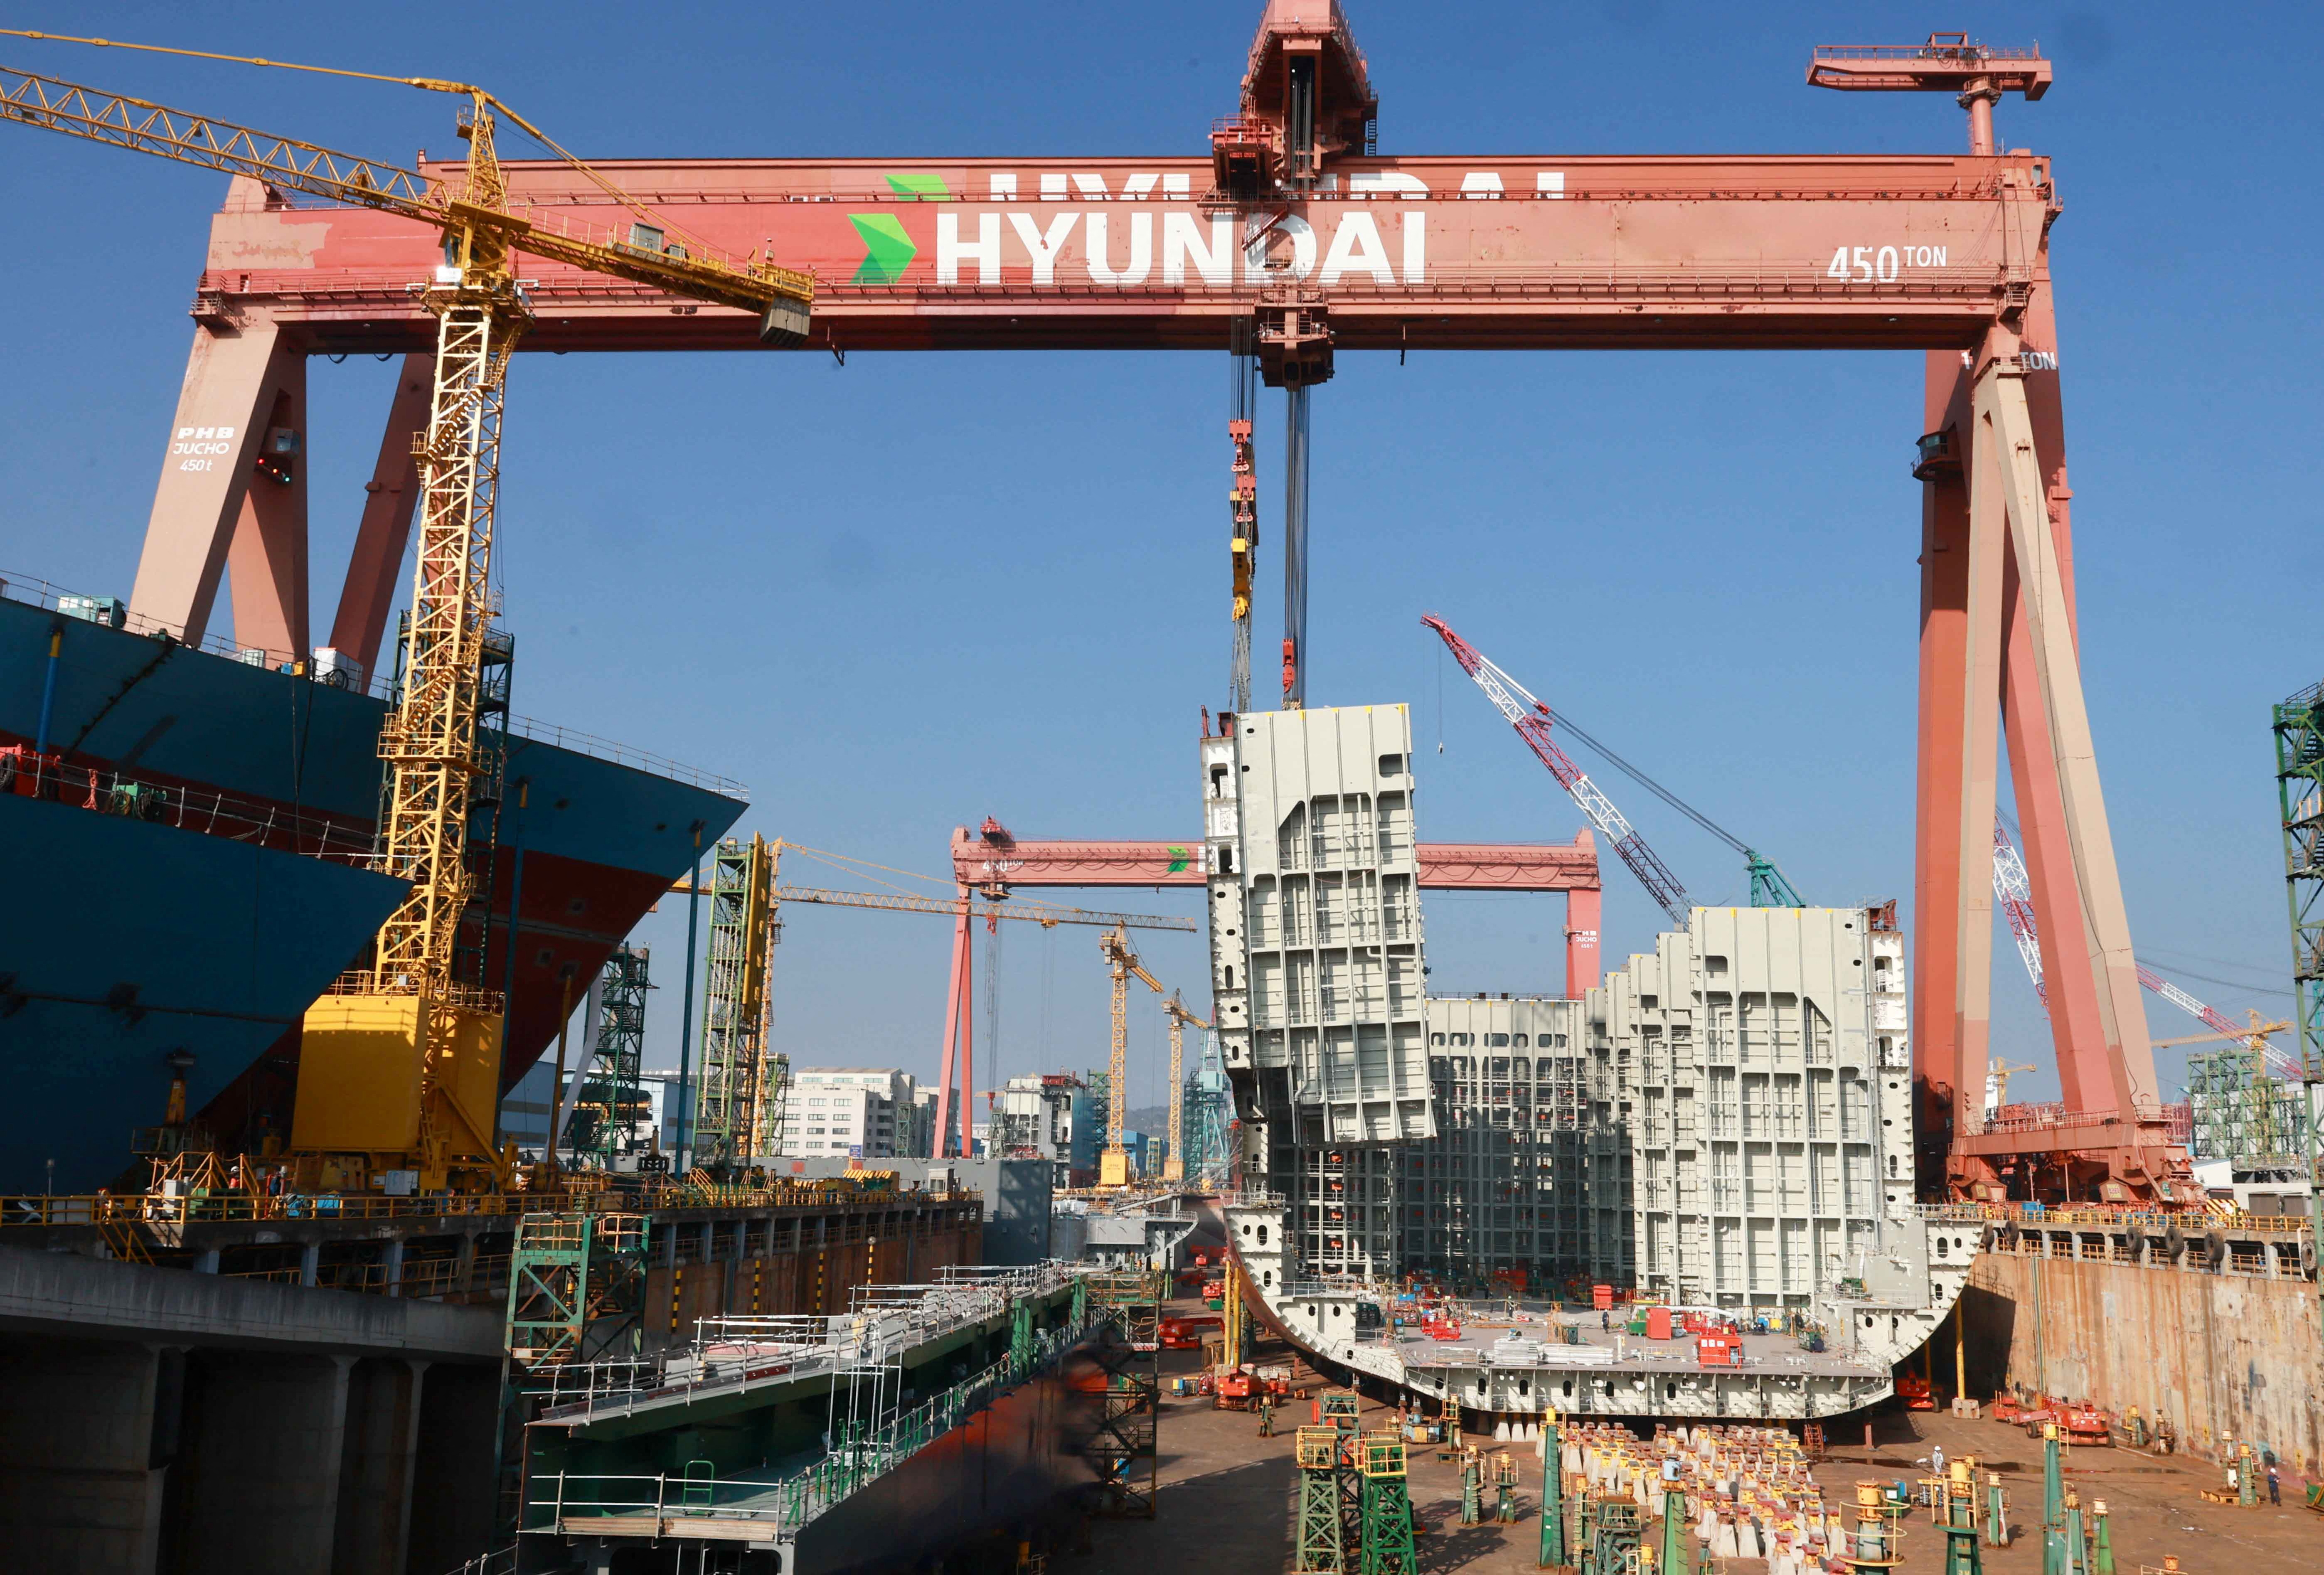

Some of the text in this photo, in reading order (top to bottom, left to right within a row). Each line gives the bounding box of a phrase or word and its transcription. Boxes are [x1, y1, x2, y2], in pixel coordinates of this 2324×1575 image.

[937, 212, 1425, 286] HYUNDAI
[1827, 246, 1947, 283] 450 TON
[2019, 351, 2057, 370] TON
[177, 427, 234, 439] PHB
[173, 443, 229, 455] JUCHO
[180, 459, 213, 472] 450 t
